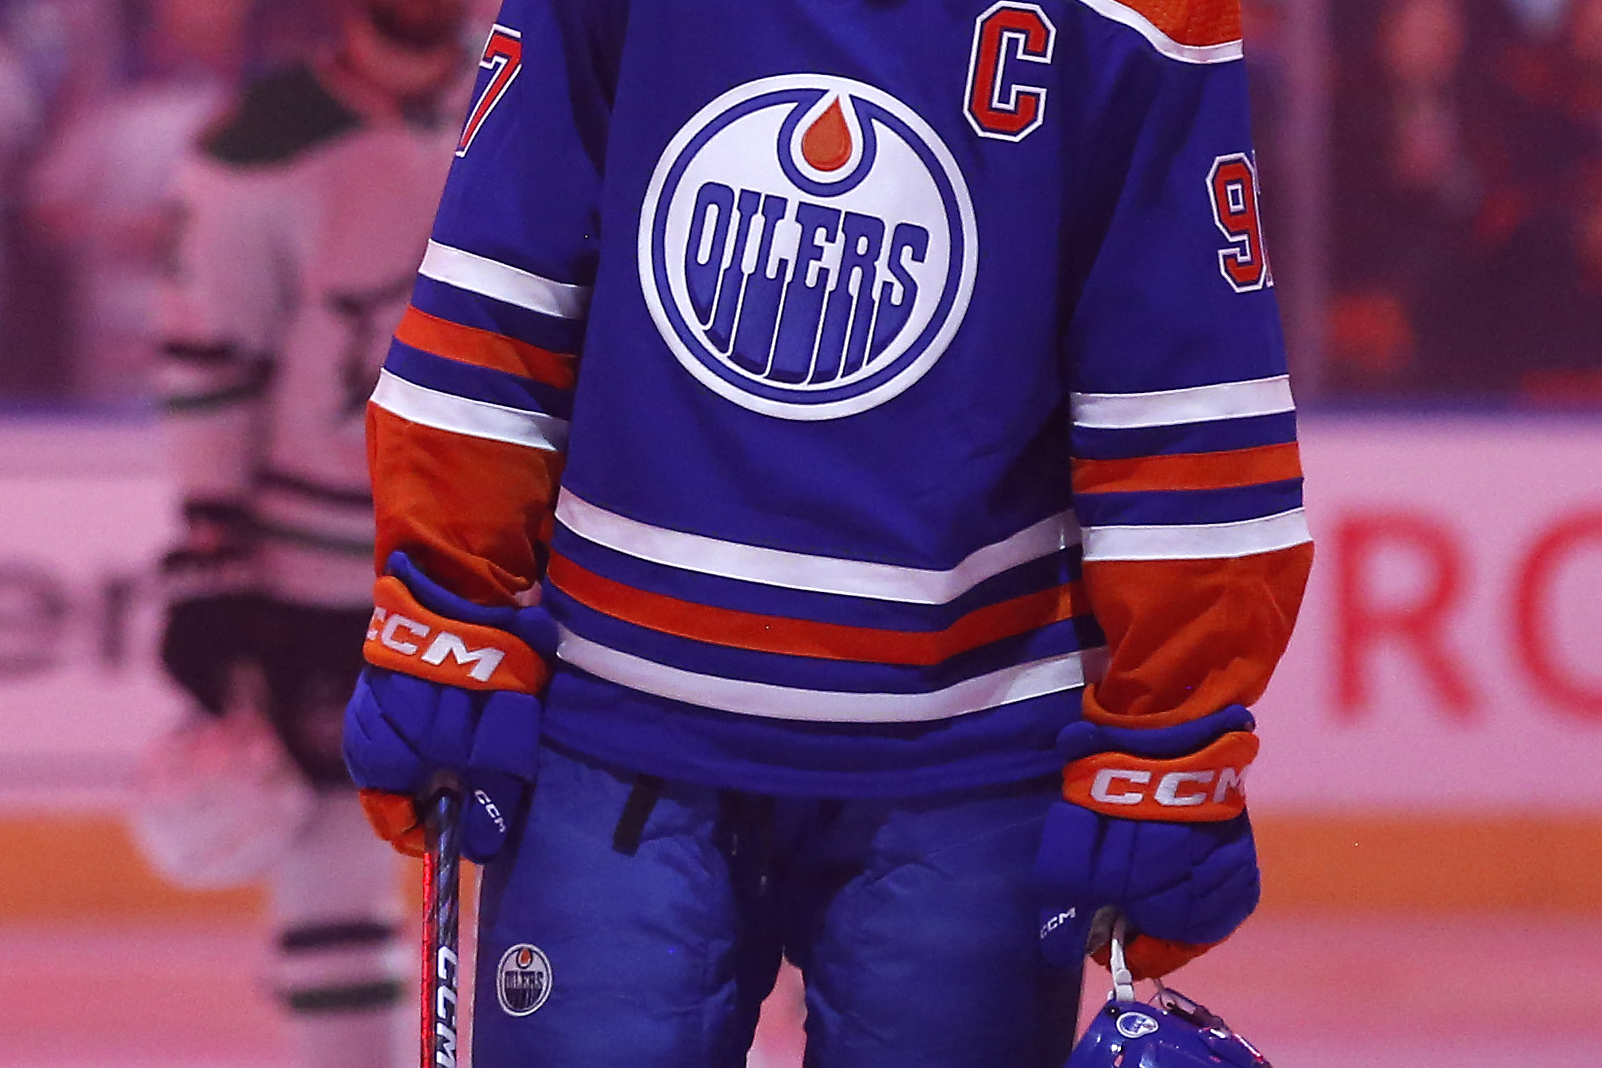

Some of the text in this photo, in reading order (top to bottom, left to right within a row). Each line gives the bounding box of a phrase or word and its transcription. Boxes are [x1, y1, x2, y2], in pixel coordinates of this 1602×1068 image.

[963, 0, 1056, 142] C
[684, 181, 930, 386] OILERS
[1205, 149, 1274, 293] 9
[474, 790, 506, 833] CCM
[1039, 907, 1076, 939] CCM
[436, 945, 458, 1068] CCM
